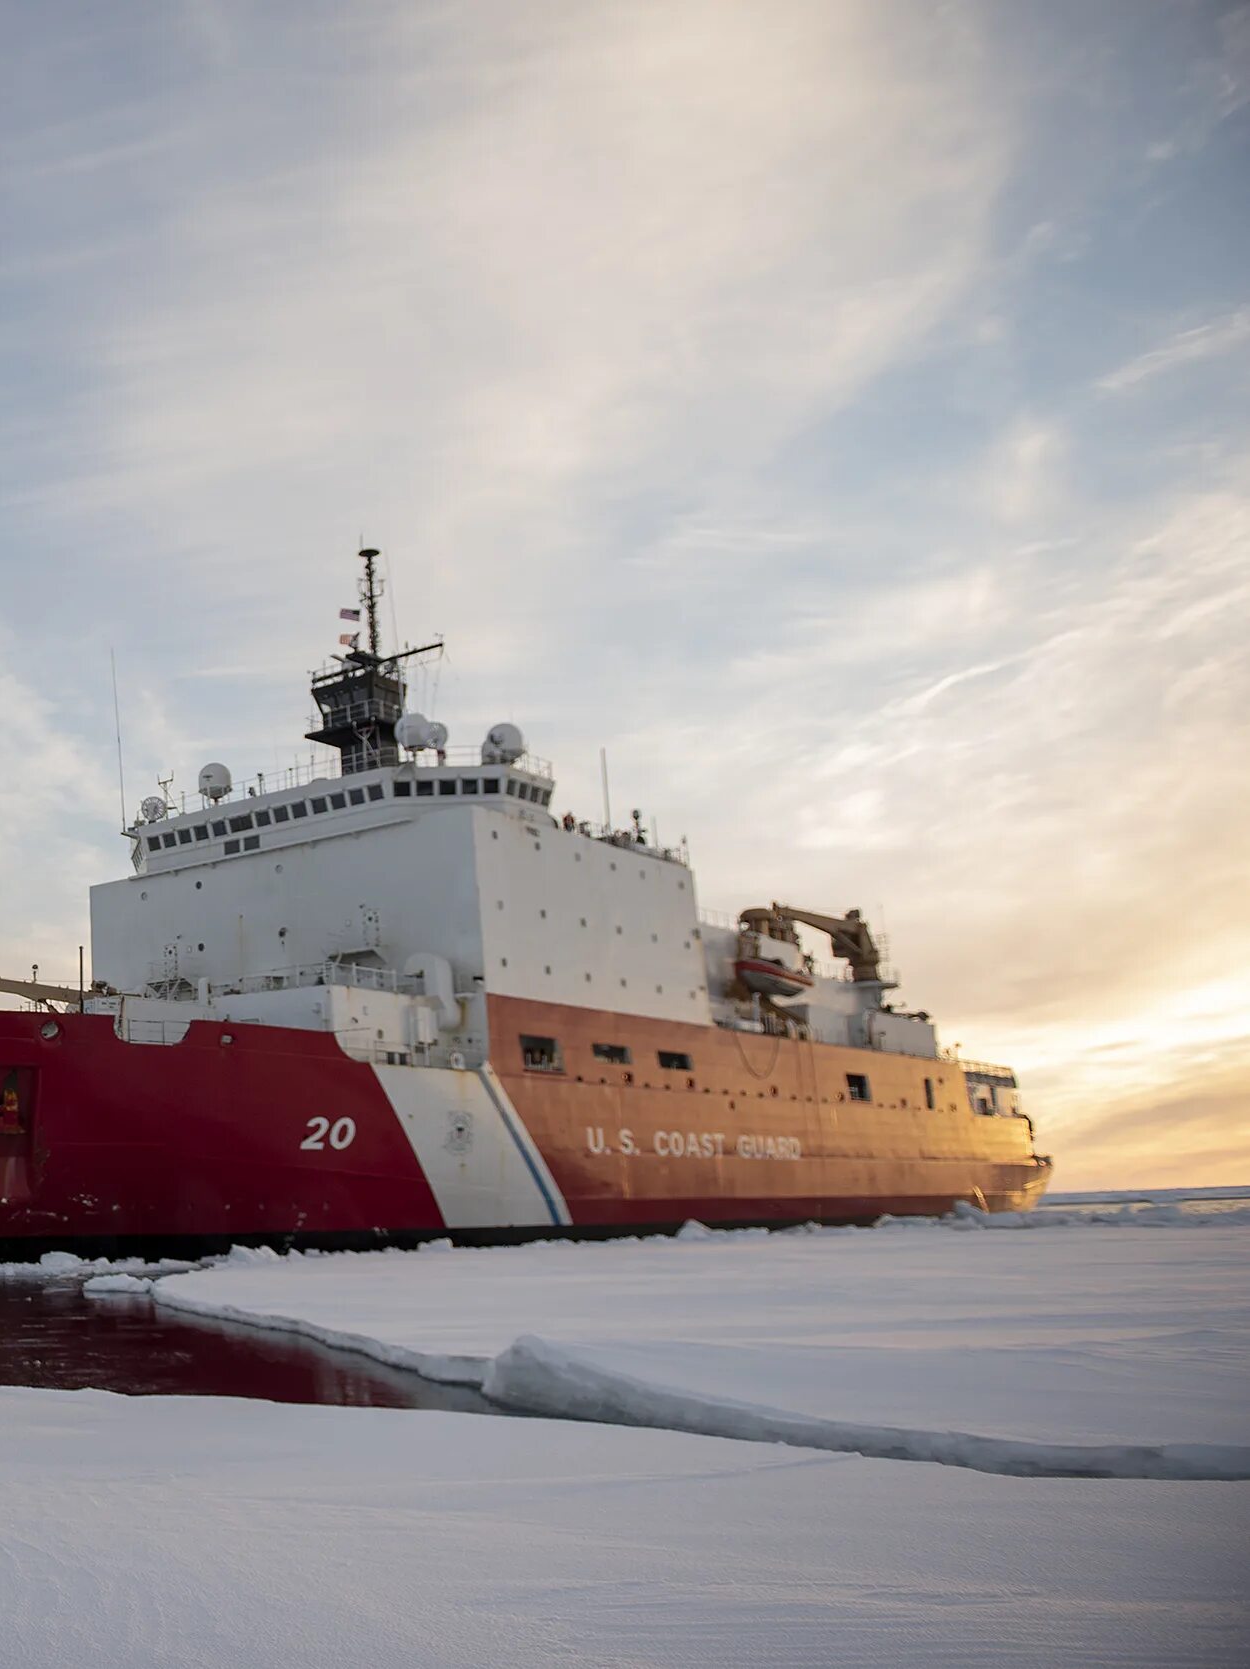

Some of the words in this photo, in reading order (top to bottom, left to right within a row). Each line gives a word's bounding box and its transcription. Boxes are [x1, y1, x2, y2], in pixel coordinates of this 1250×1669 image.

[299, 1116, 356, 1150] 20
[653, 1130, 726, 1159] COAST
[737, 1134, 802, 1161] GUARD
